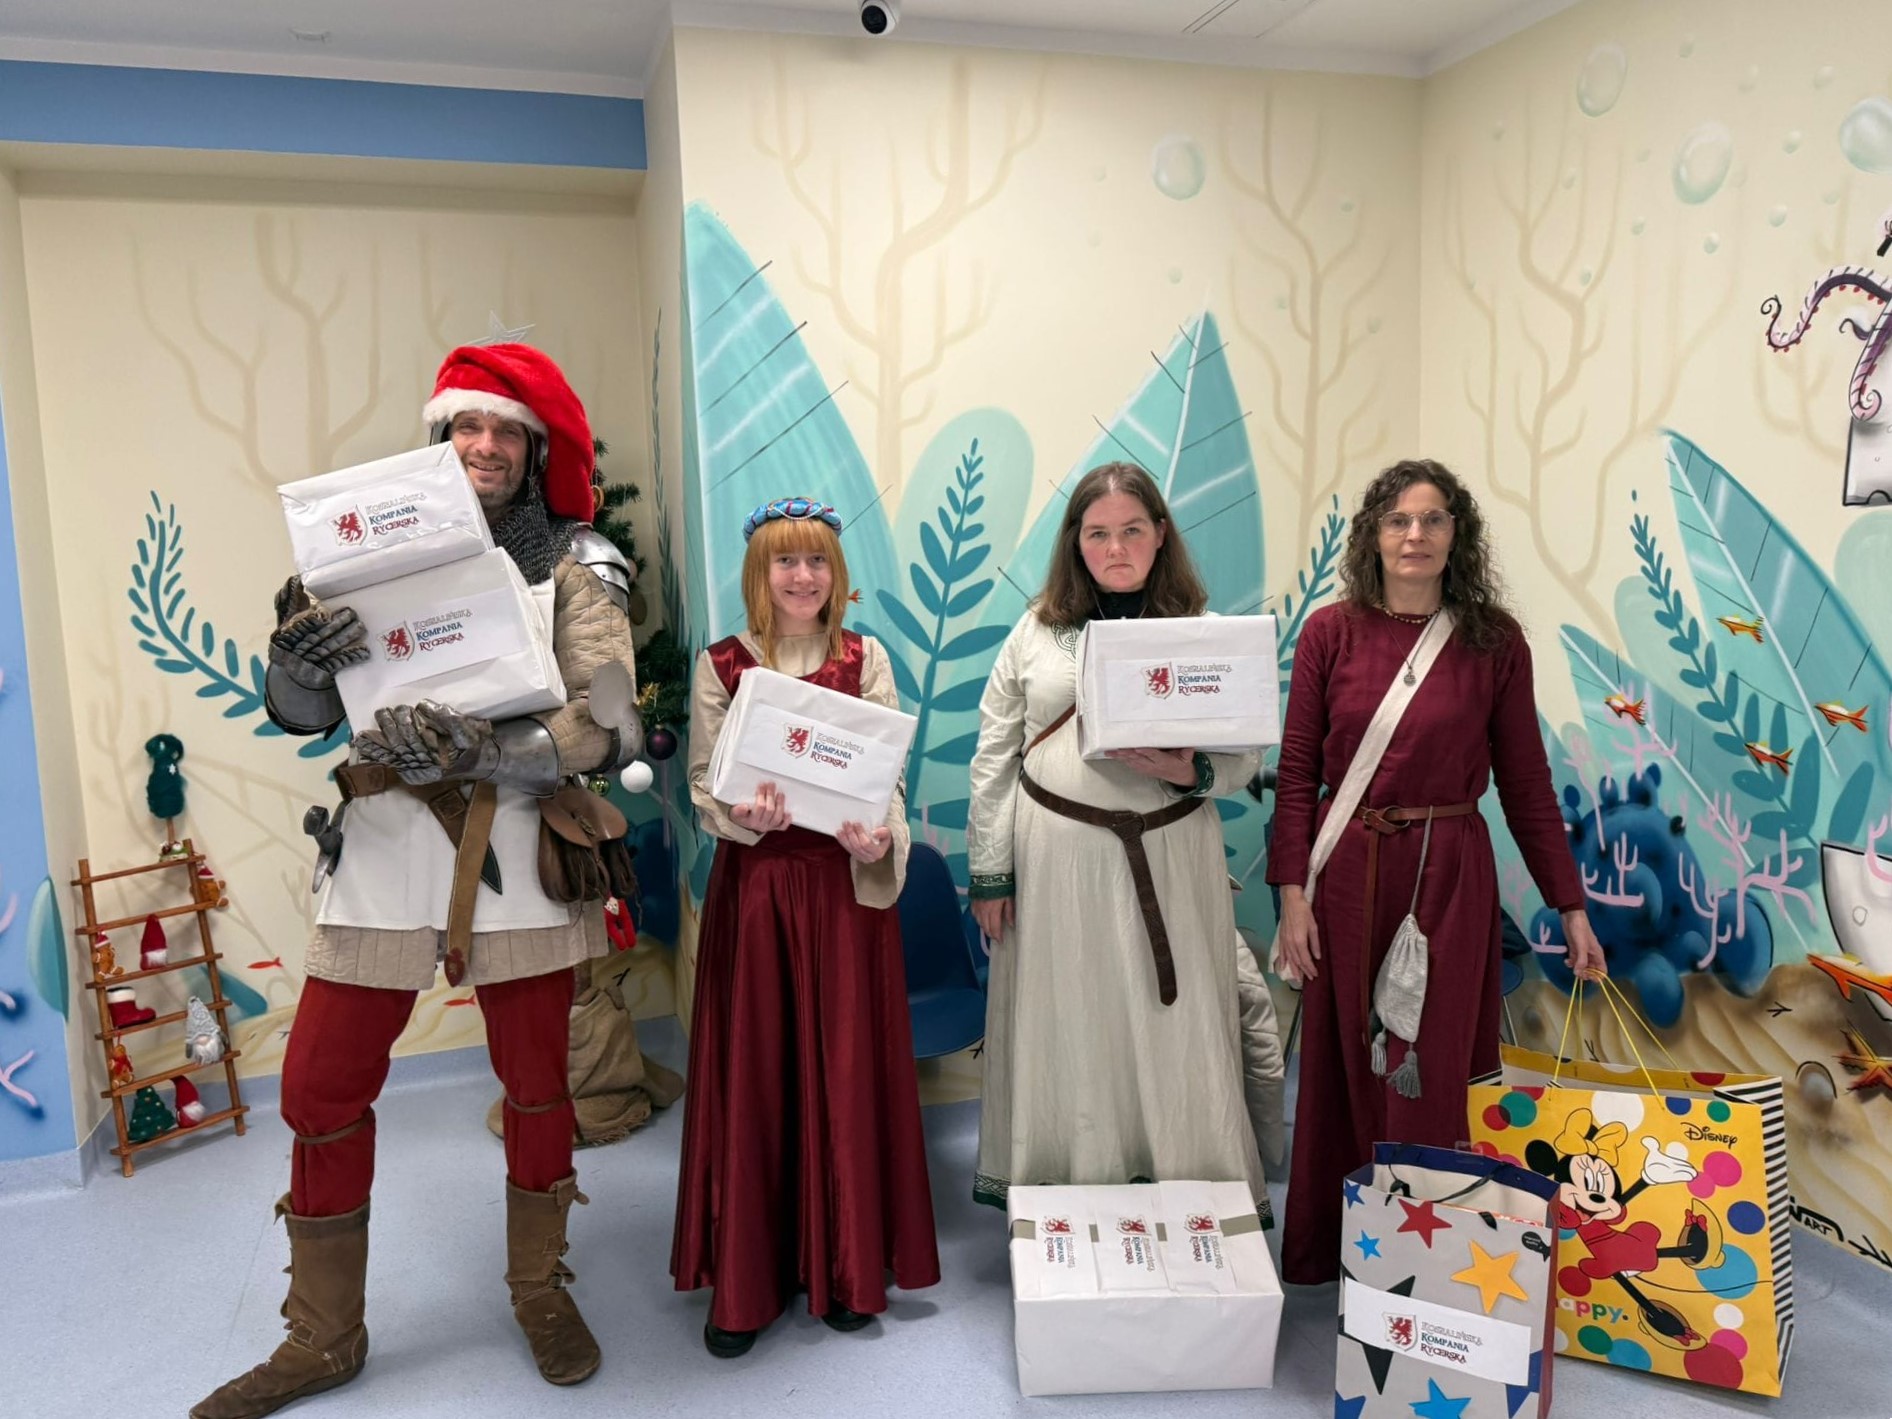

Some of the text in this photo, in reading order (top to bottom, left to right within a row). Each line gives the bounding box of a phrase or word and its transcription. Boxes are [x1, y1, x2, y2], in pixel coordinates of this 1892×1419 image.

[369, 504, 418, 526] KOMPANIA
[373, 516, 419, 535] RYCERSKA
[416, 621, 463, 641] KOMPANIA
[419, 632, 464, 651] RYCERSKA
[1177, 675, 1221, 685] KOMPANIA
[1178, 685, 1220, 696] RYCERSKA
[813, 741, 852, 760] KOMPANIA
[810, 751, 848, 770] RYCERSKA
[1803, 1216, 1833, 1236] ART
[1557, 1297, 1629, 1324] appy.
[1421, 1332, 1469, 1353] KOMPANIA
[1420, 1343, 1467, 1364] RYCERSKA
